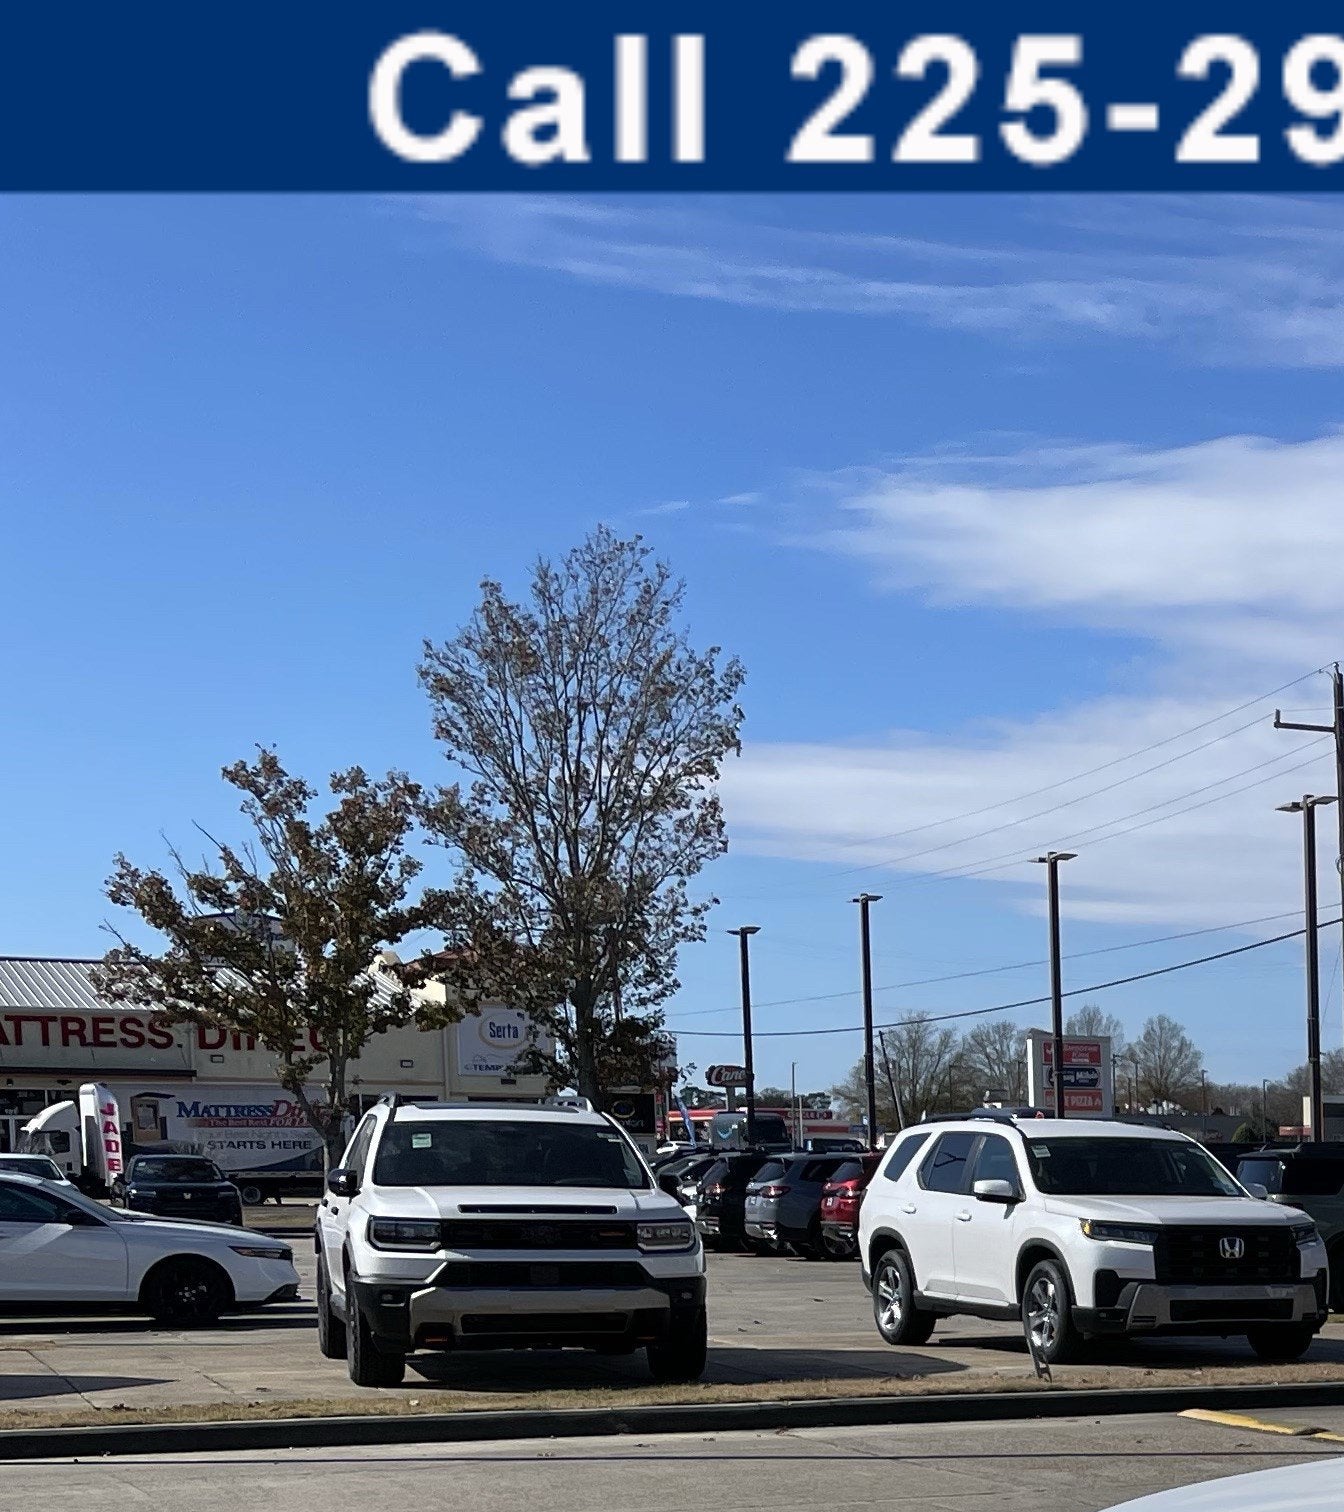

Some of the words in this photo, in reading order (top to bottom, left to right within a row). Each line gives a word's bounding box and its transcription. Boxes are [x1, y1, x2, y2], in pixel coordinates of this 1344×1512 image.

[489, 1021, 519, 1039] Serta
[711, 1066, 747, 1085] Cane
[100, 1103, 122, 1171] JADE
[208, 1140, 267, 1150] STARTS
[271, 1140, 312, 1150] HERE
